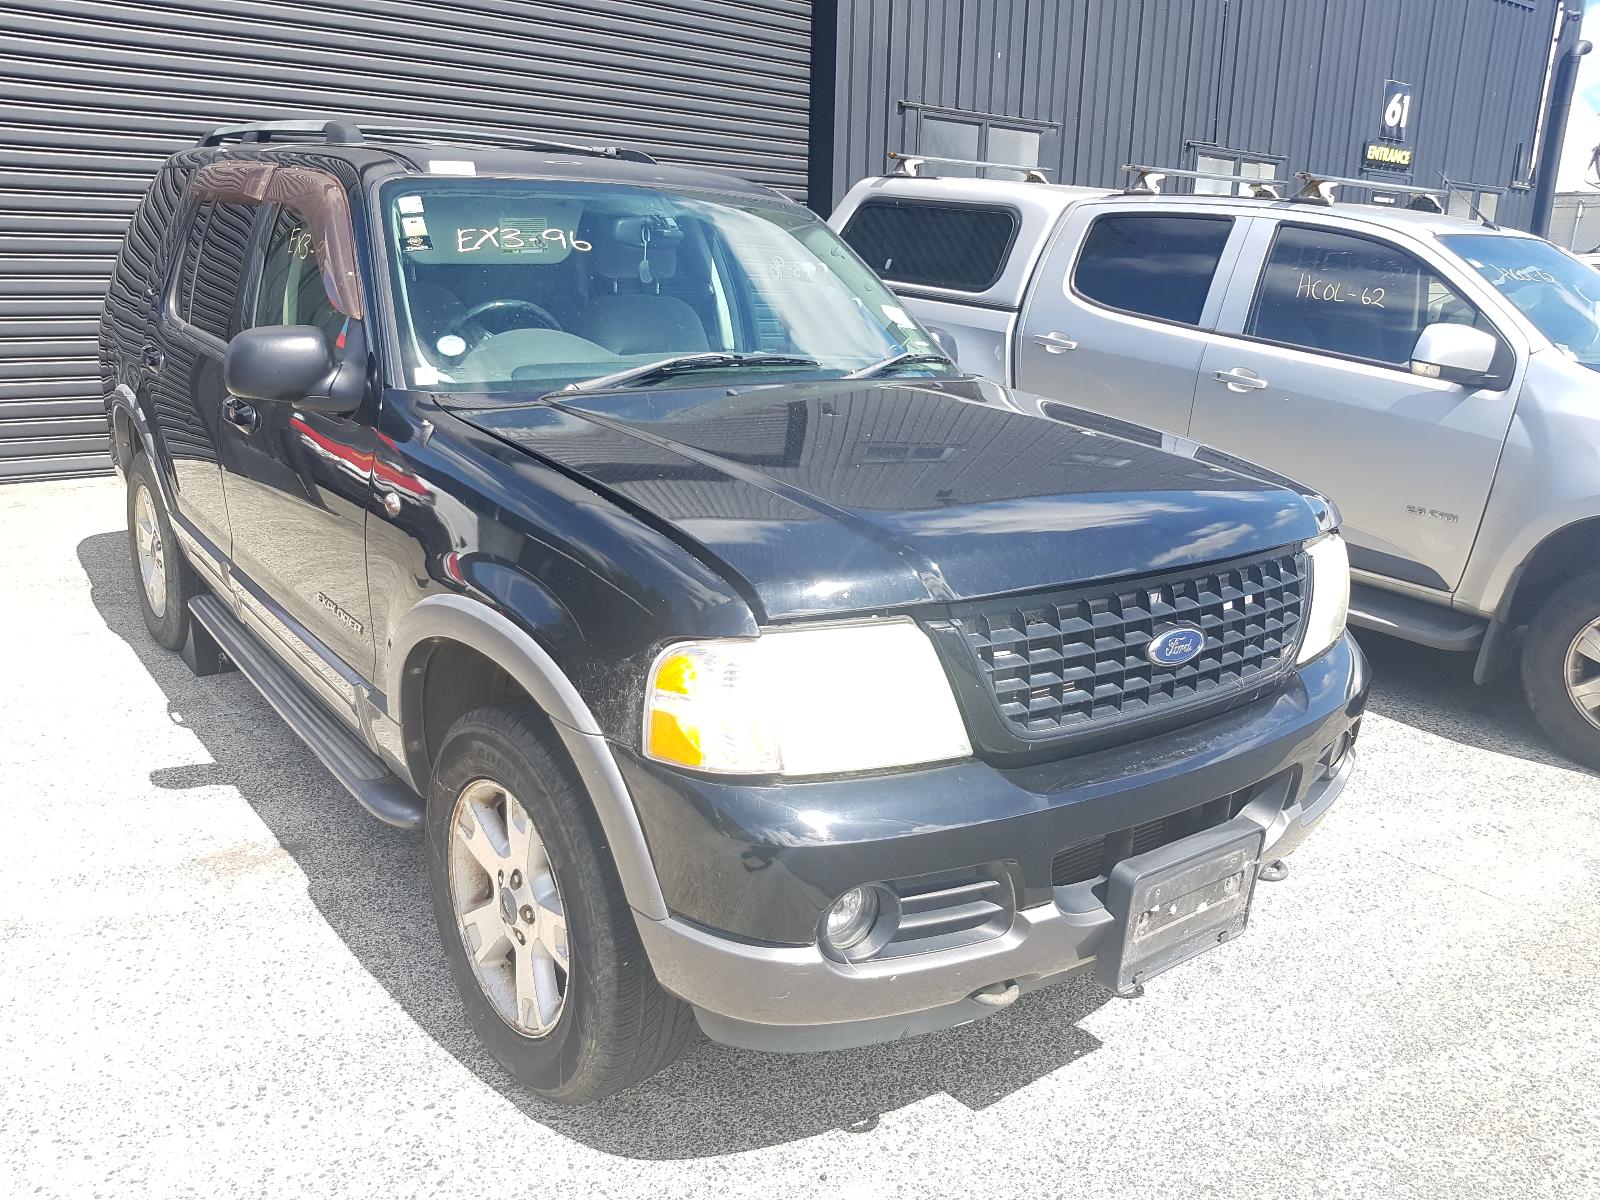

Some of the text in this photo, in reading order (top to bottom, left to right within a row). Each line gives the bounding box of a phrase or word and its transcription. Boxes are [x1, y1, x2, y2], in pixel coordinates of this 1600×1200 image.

[1384, 93, 1411, 128] 61
[1366, 145, 1412, 165] ENTRANCE
[456, 226, 593, 252] EX3-96
[1296, 272, 1385, 308] HCOL-62
[316, 591, 364, 635] EXPLORER
[1165, 636, 1193, 657] Ford
